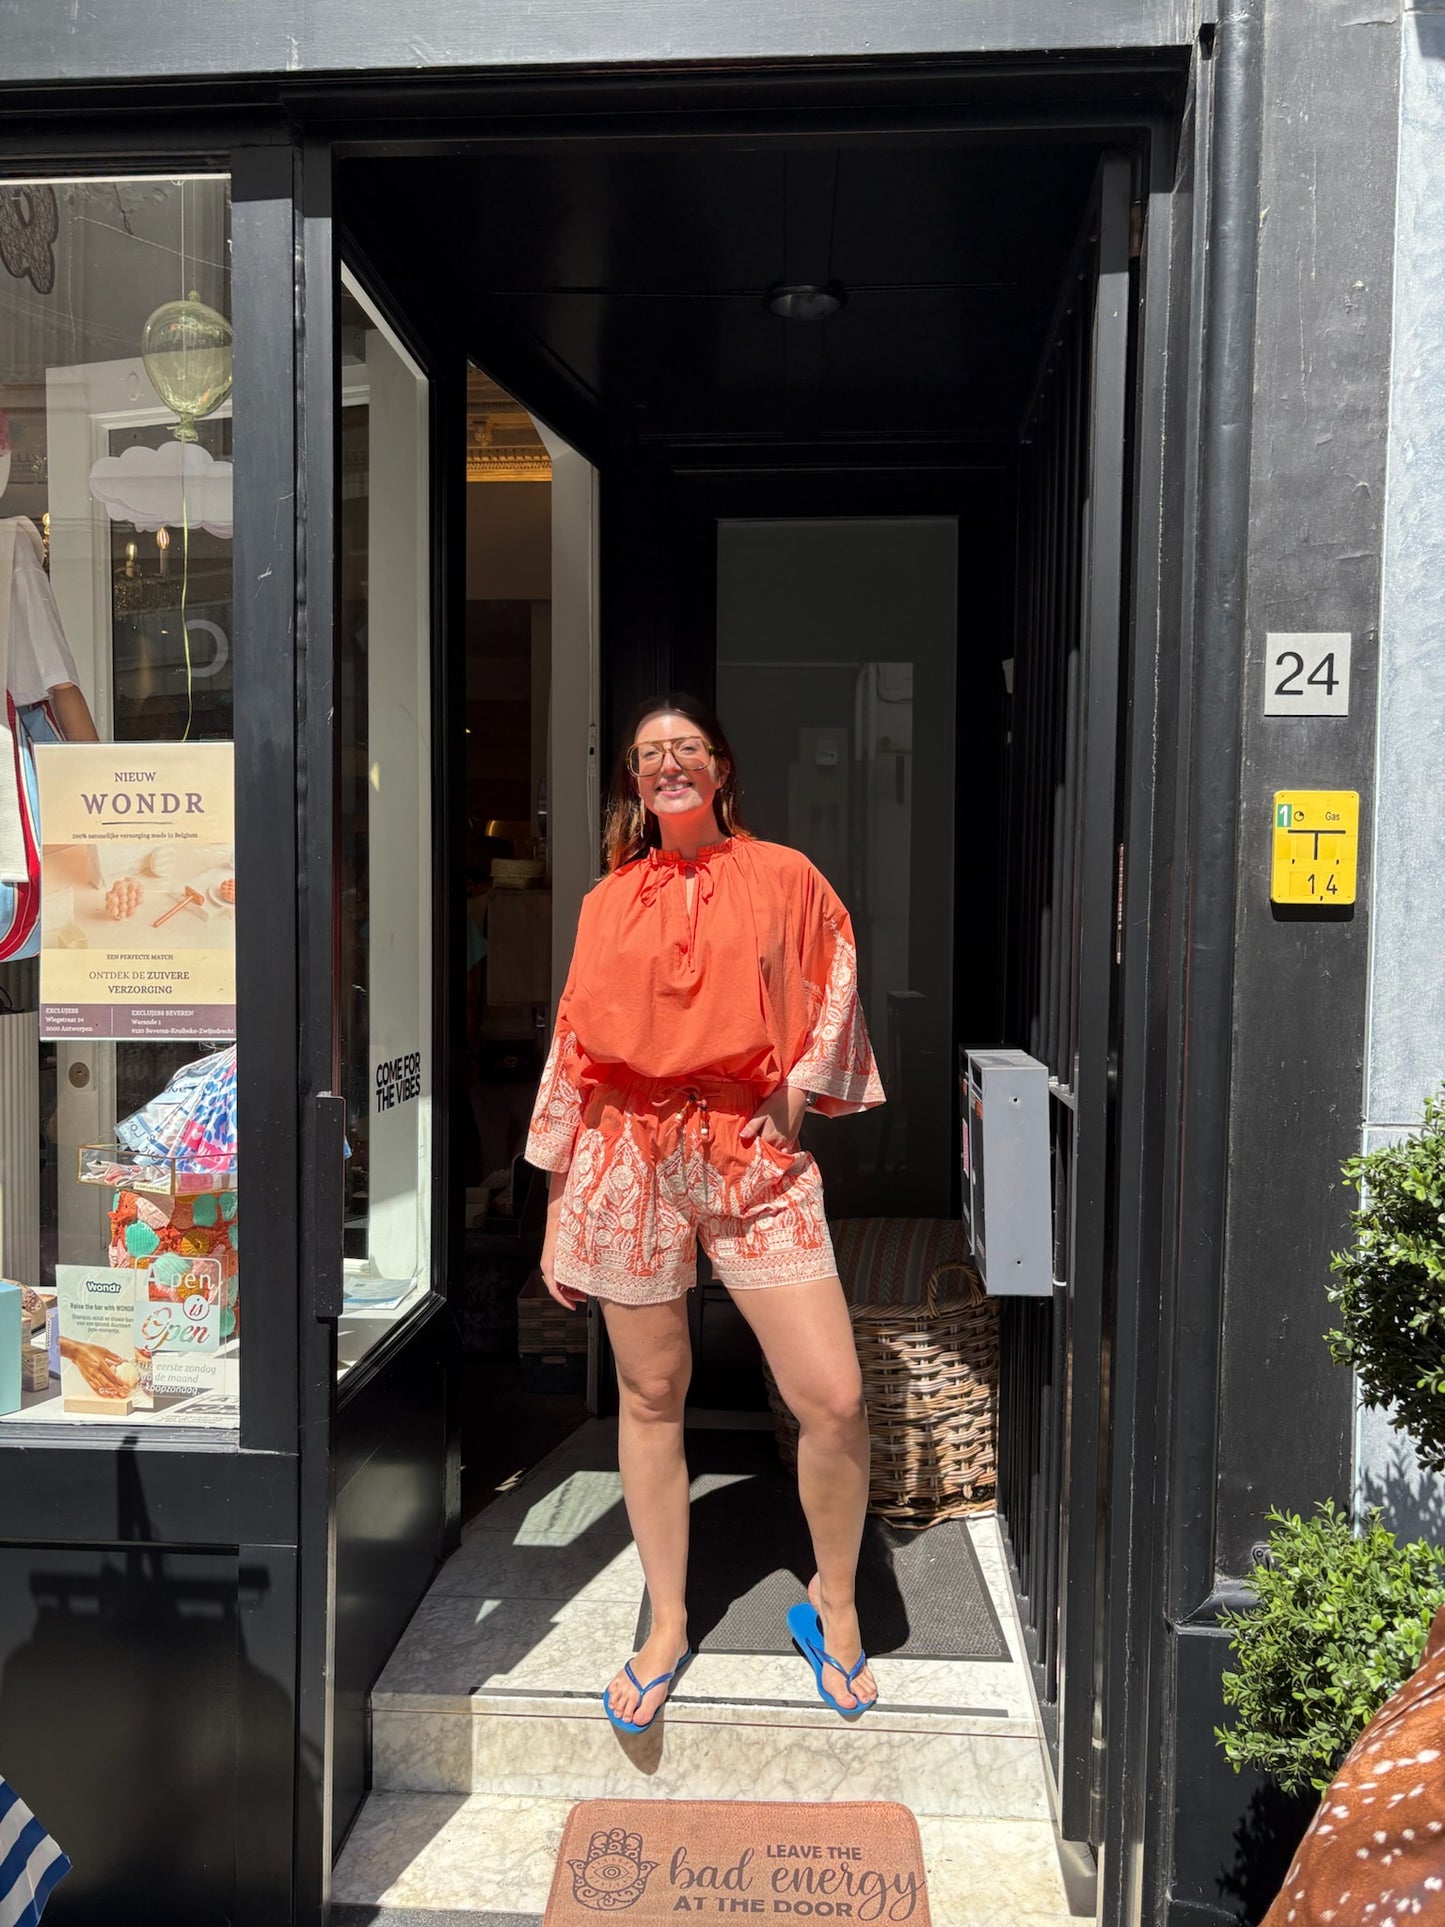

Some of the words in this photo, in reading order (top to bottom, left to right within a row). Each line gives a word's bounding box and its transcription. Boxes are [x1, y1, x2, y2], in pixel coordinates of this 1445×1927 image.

[1274, 651, 1340, 696] 24
[114, 772, 156, 782] NIEUW
[81, 793, 205, 815] WONDR
[1279, 805, 1289, 827] 1
[1325, 811, 1341, 821] Gas
[174, 831, 198, 839] Belgium
[89, 971, 130, 980] ONTDEK
[132, 971, 146, 980] DE
[147, 971, 190, 980] ZUIVERE
[108, 985, 173, 994] VERZORGING
[376, 1058, 402, 1088] COME
[404, 1051, 421, 1078] FOR
[375, 1083, 395, 1113] THE
[396, 1073, 421, 1104] VIBES
[86, 1281, 121, 1294] Wondr
[70, 1302, 84, 1310] Raise
[188, 1297, 204, 1317] is
[141, 1306, 210, 1351] Open
[155, 1372, 166, 1381] de
[168, 1373, 199, 1383] maand
[156, 1363, 183, 1372] eerste
[185, 1364, 217, 1375] zondag
[766, 1844, 822, 1859] LEAVE
[827, 1846, 862, 1860] THE
[670, 1846, 754, 1892] bad
[771, 1861, 926, 1922] energy
[673, 1895, 708, 1912] AT
[715, 1897, 765, 1913] THE
[773, 1900, 853, 1917] DOOR
